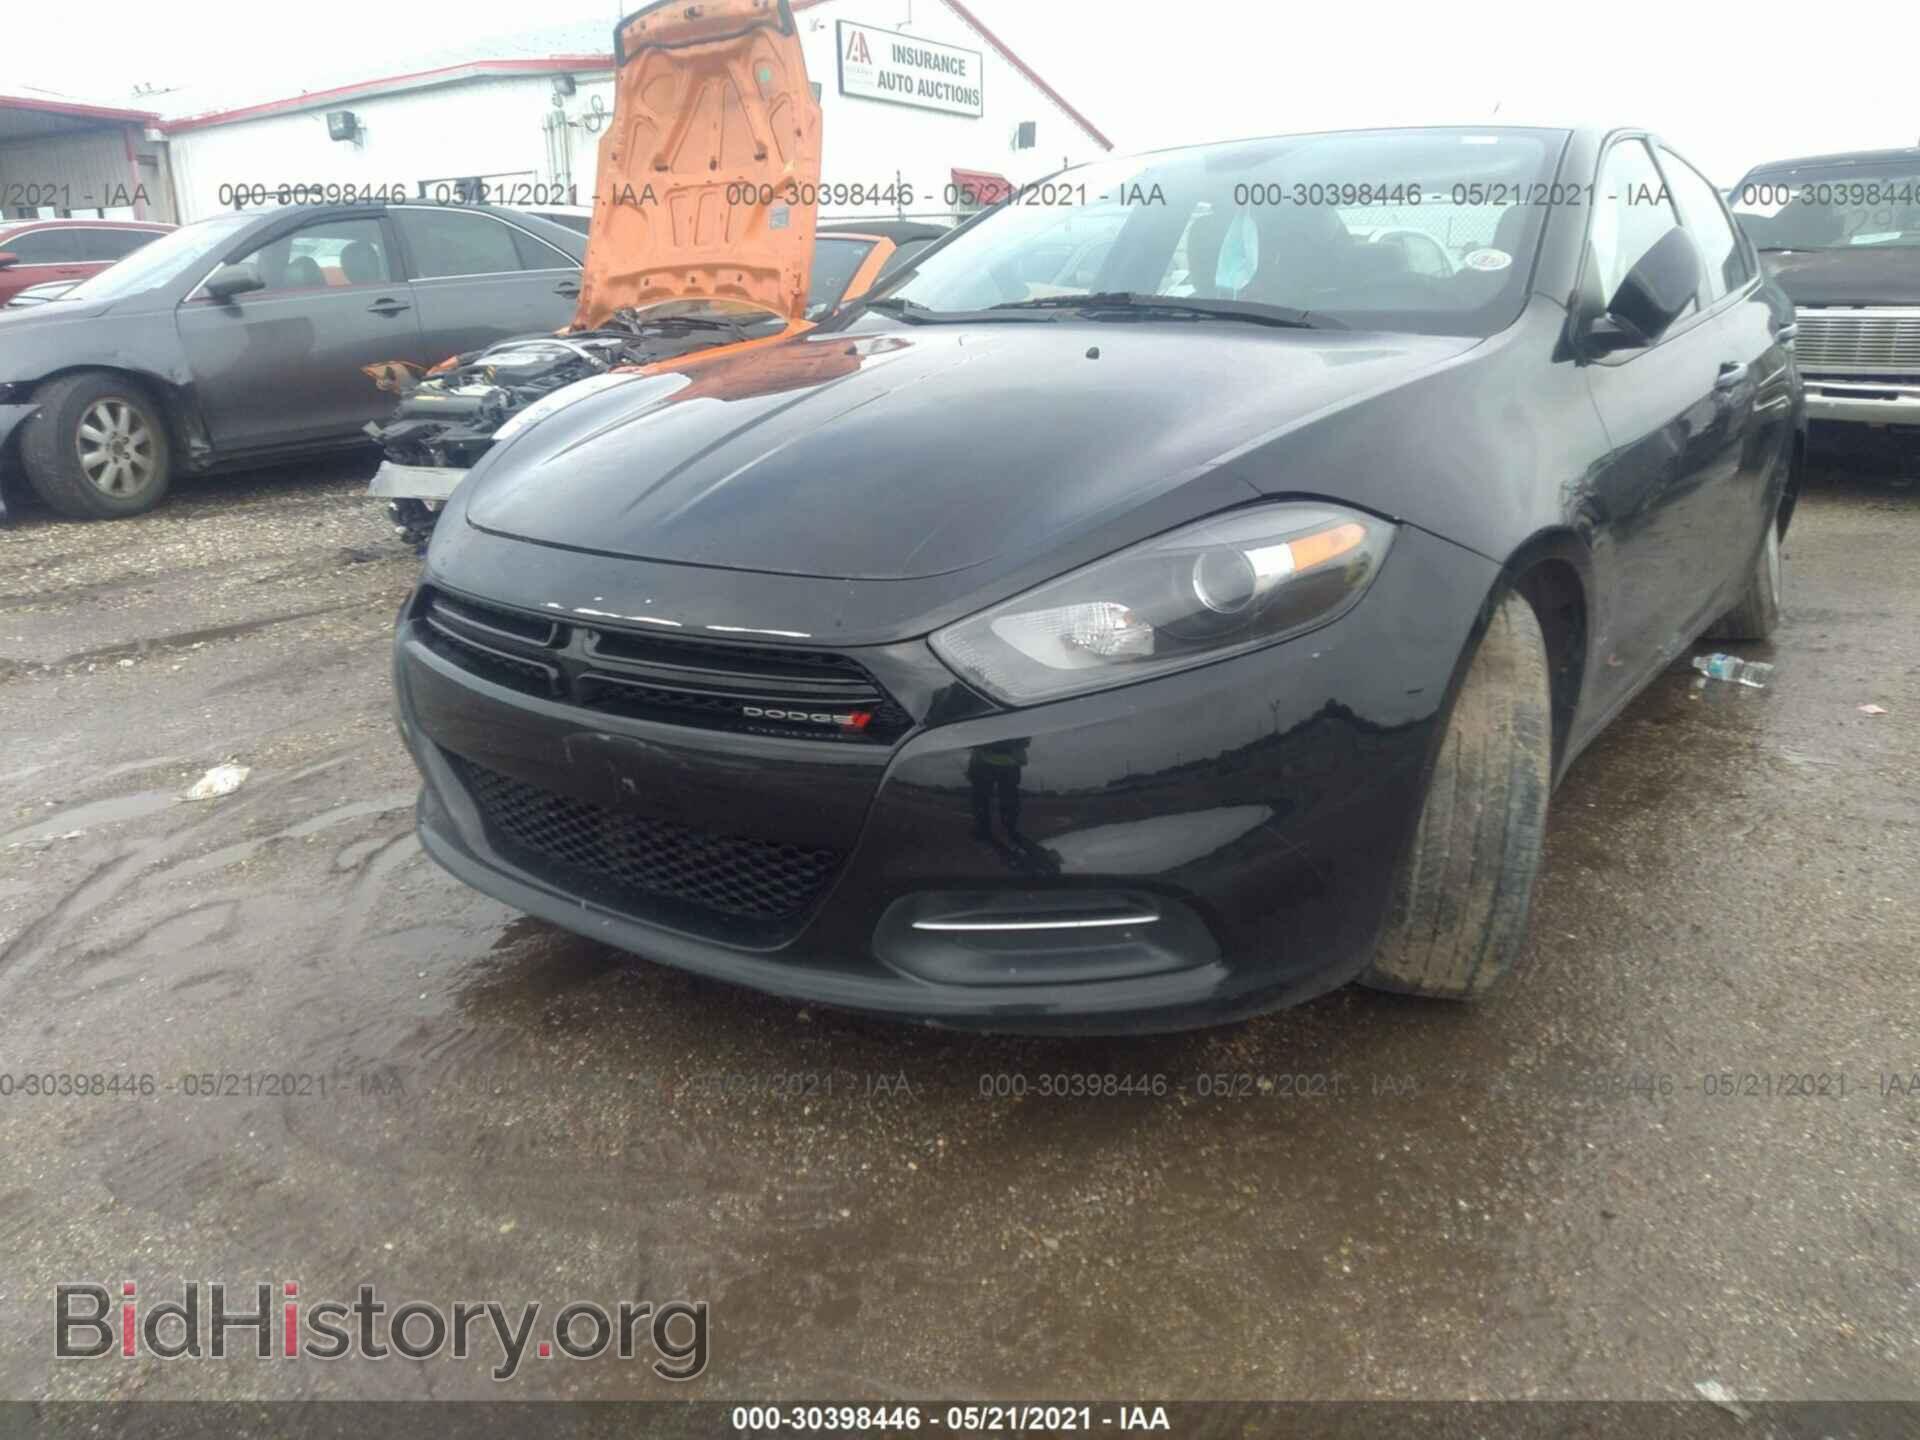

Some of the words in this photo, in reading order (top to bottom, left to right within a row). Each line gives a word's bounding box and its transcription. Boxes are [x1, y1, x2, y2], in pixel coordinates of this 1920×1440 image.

[892, 43, 966, 77] INSURANCE
[877, 70, 914, 94] AUTO
[917, 78, 980, 107] AUCTIONS
[742, 706, 854, 725] DODGE
